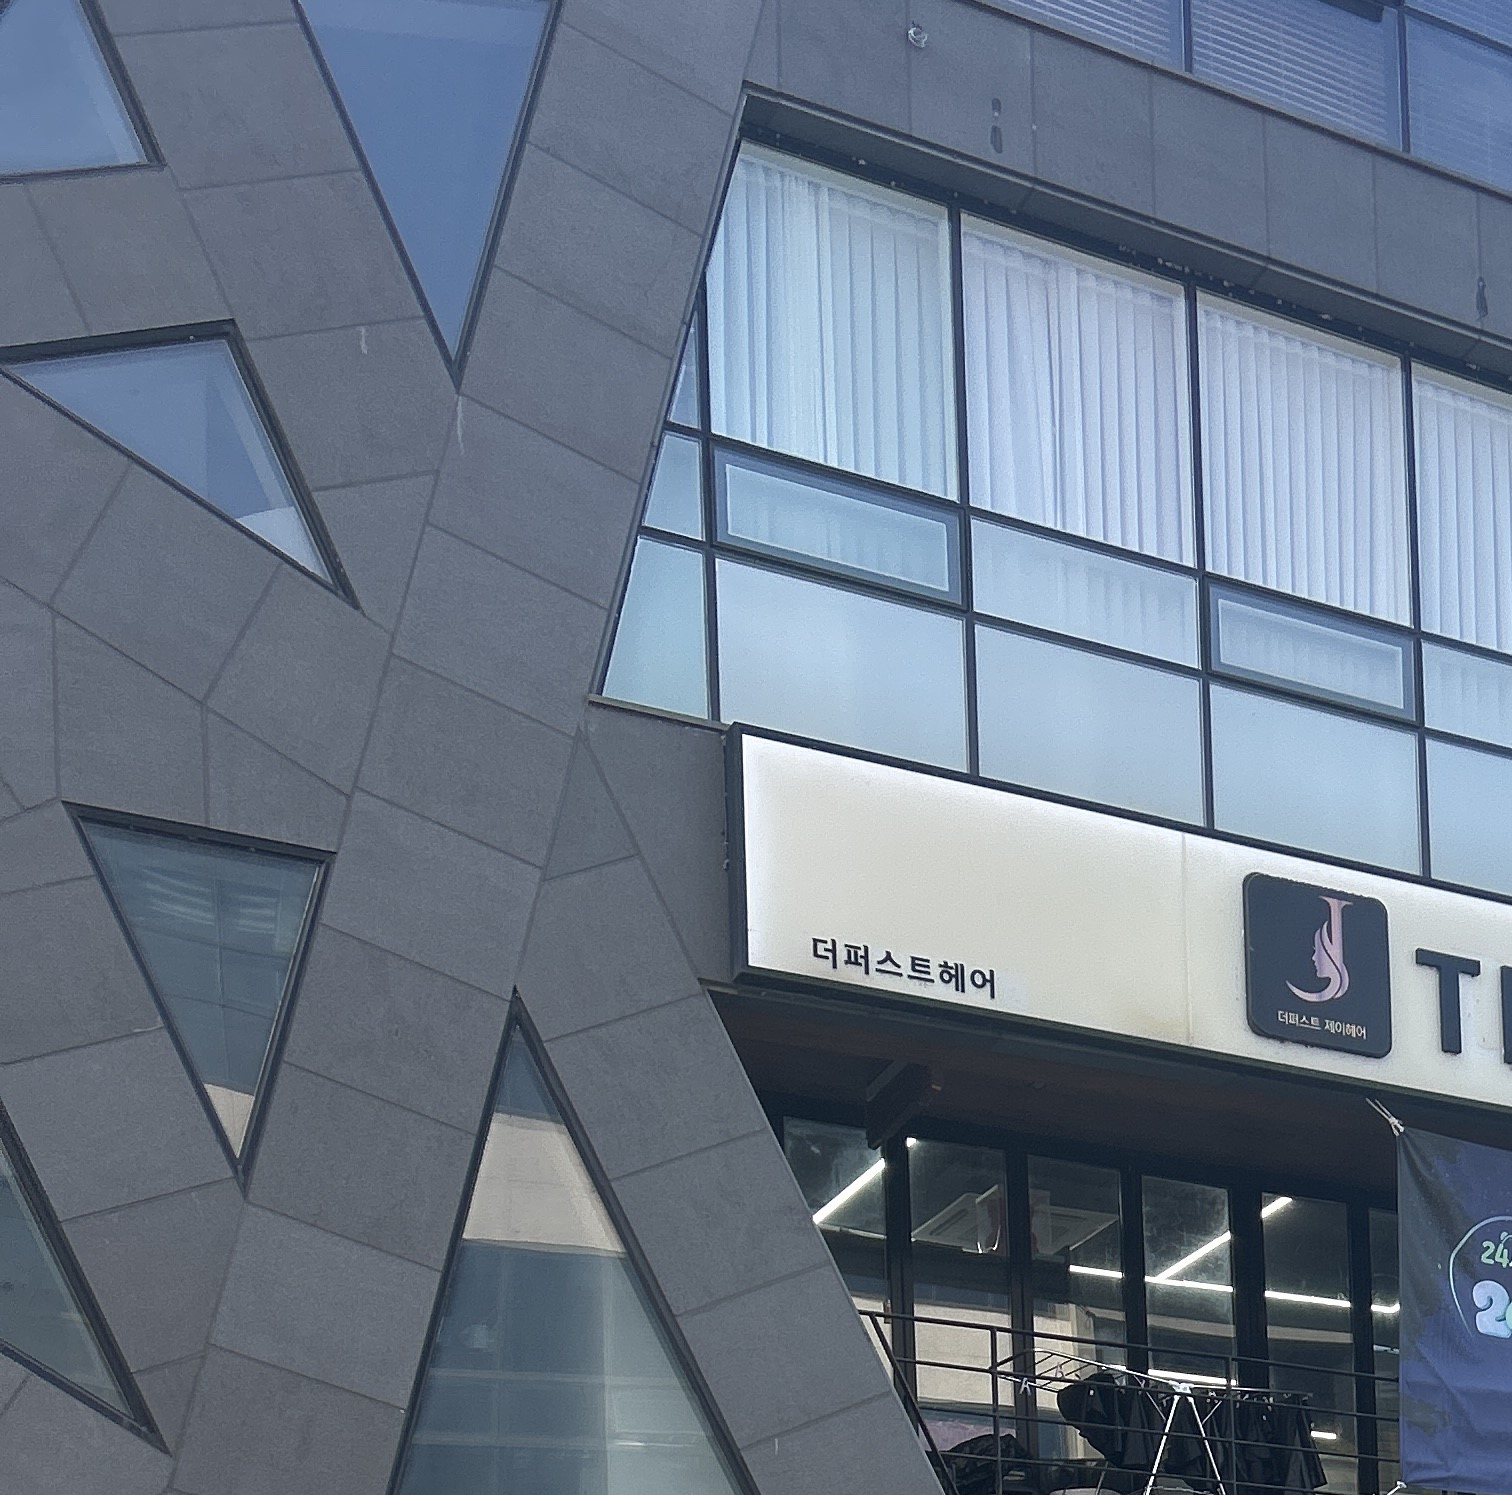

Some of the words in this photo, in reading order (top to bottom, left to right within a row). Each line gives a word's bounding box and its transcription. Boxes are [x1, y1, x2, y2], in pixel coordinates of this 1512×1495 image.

[811, 937, 995, 999] 더퍼스트헤어
[1277, 1010, 1322, 1030] 더퍼스트
[1324, 1019, 1367, 1040] 제이헤어
